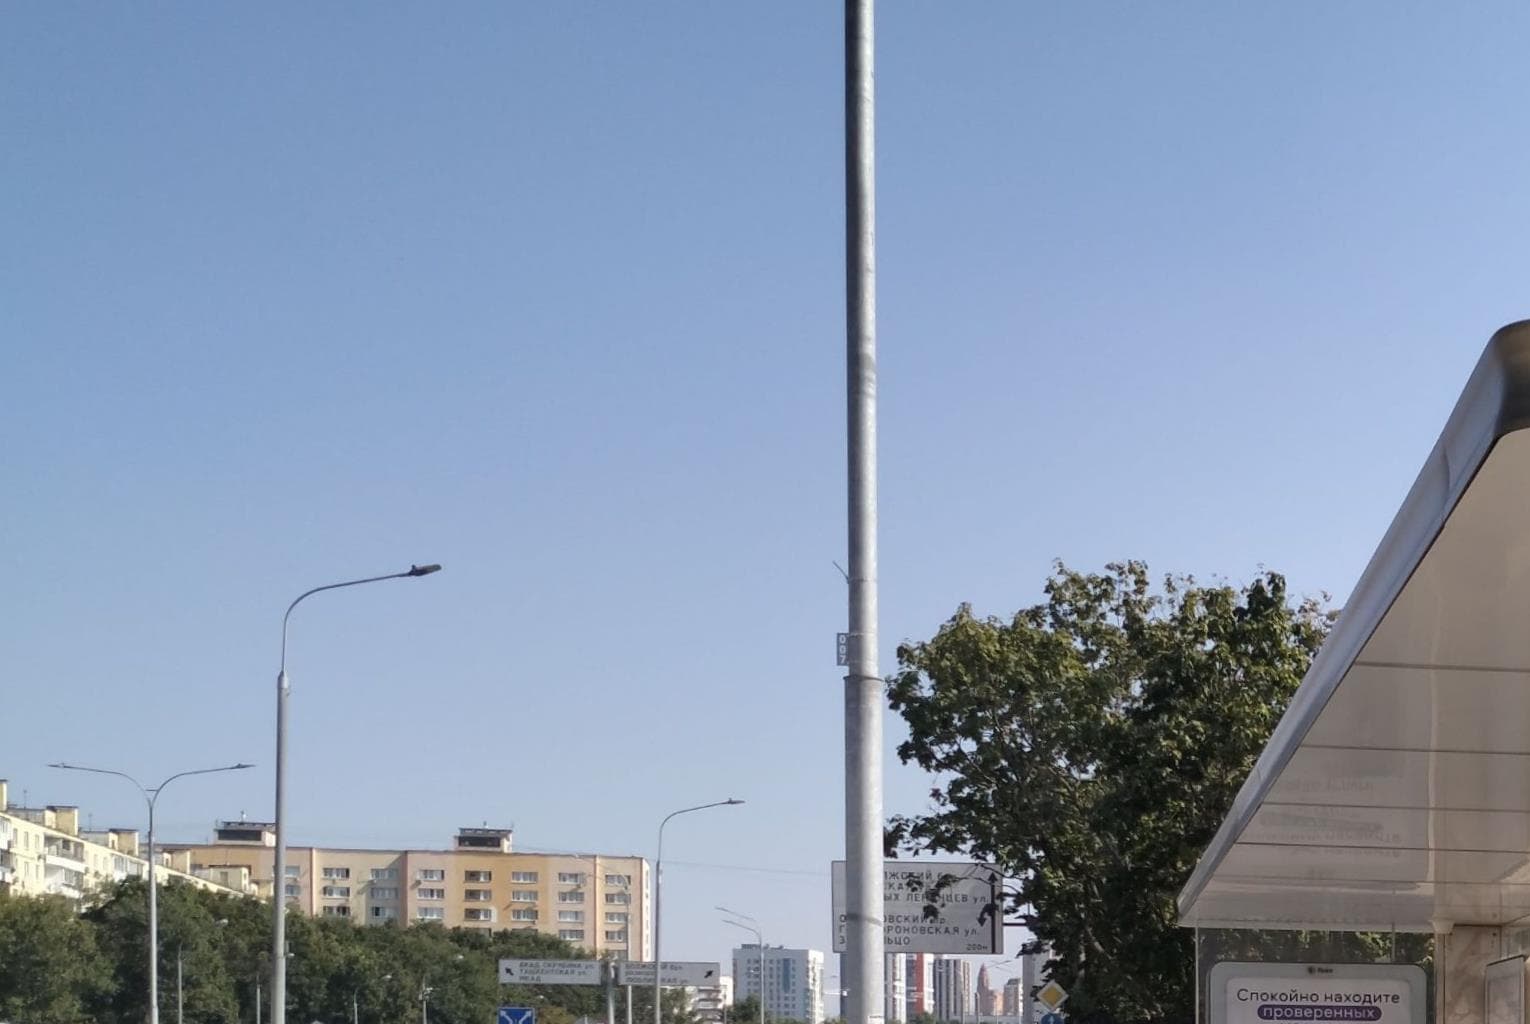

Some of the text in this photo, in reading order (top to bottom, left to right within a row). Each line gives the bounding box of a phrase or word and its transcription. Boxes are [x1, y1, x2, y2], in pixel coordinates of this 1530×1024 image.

[1236, 988, 1400, 1005] Спокойно находите
[1262, 1006, 1376, 1021] проверенных
